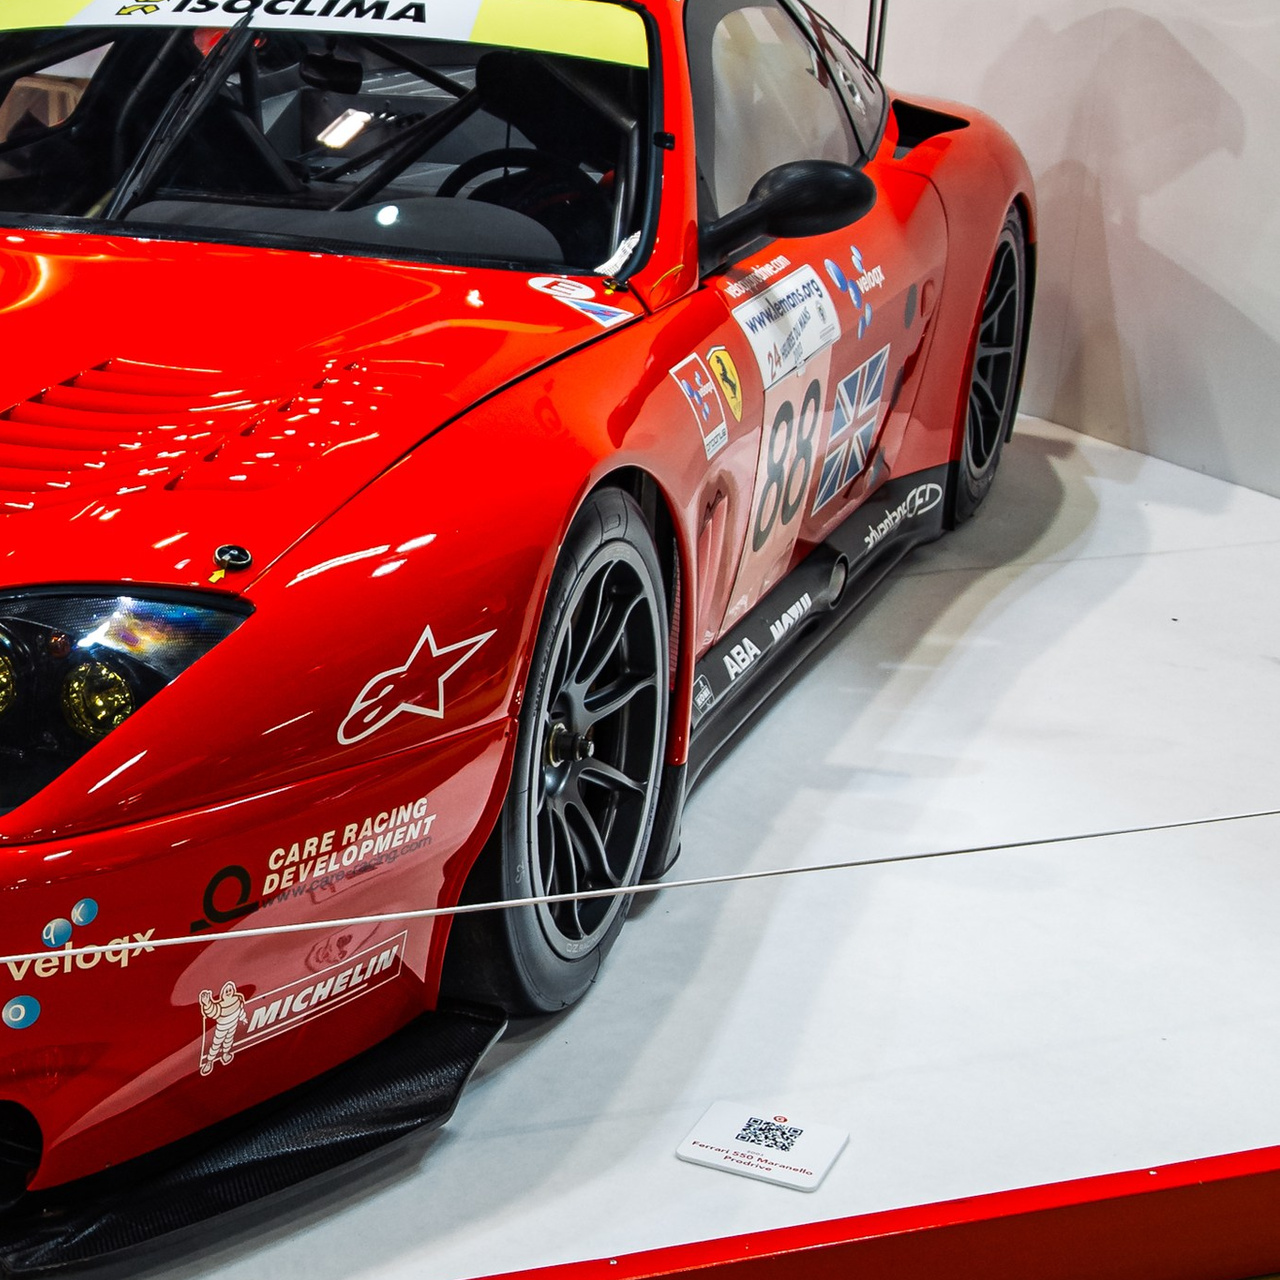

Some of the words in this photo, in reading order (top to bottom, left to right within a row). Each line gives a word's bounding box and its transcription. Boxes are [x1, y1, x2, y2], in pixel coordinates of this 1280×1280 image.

[745, 277, 824, 334] www.lemans.org
[767, 343, 782, 380] 24
[752, 378, 821, 552] 88
[722, 636, 761, 681] ABA
[262, 814, 437, 896] DEVELOPMENT
[268, 830, 336, 870] CARE
[341, 797, 428, 846] RACING
[261, 834, 432, 909] www.care-racing.com
[6, 928, 156, 982] veloqx
[247, 944, 399, 1033] MICHELIN
[692, 1139, 730, 1155] Ferrari
[732, 1150, 754, 1162] 550
[757, 1156, 814, 1177] Maranello
[723, 1154, 773, 1172] Prodrive
